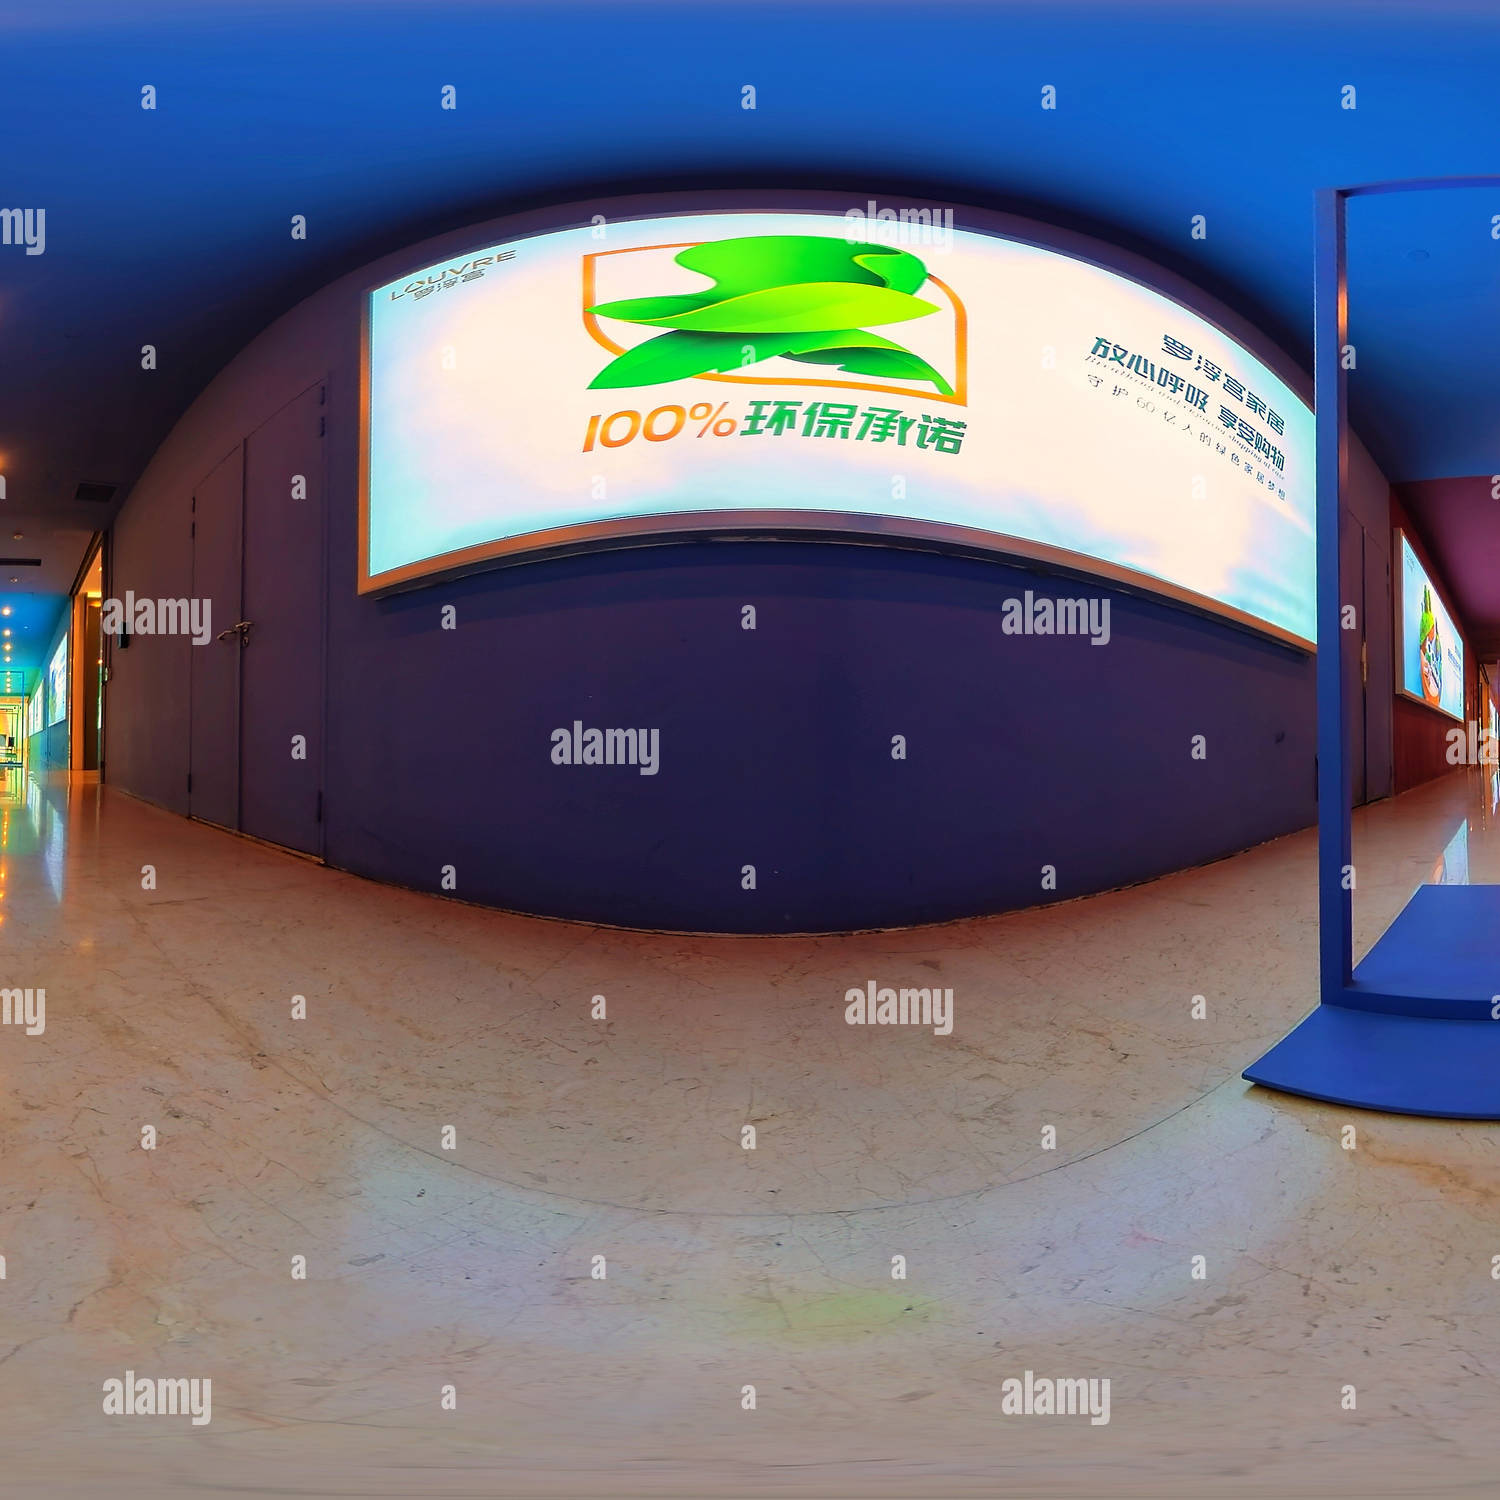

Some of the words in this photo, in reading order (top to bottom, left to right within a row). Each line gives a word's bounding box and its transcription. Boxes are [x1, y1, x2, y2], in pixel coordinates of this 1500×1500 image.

[390, 249, 517, 301] LOUVRE
[1090, 336, 1210, 413] 放心呼吸
[1217, 404, 1285, 472] 享受购物
[1161, 334, 1285, 437] 罗浮宫家居
[582, 399, 968, 455] 100%环保承诺
